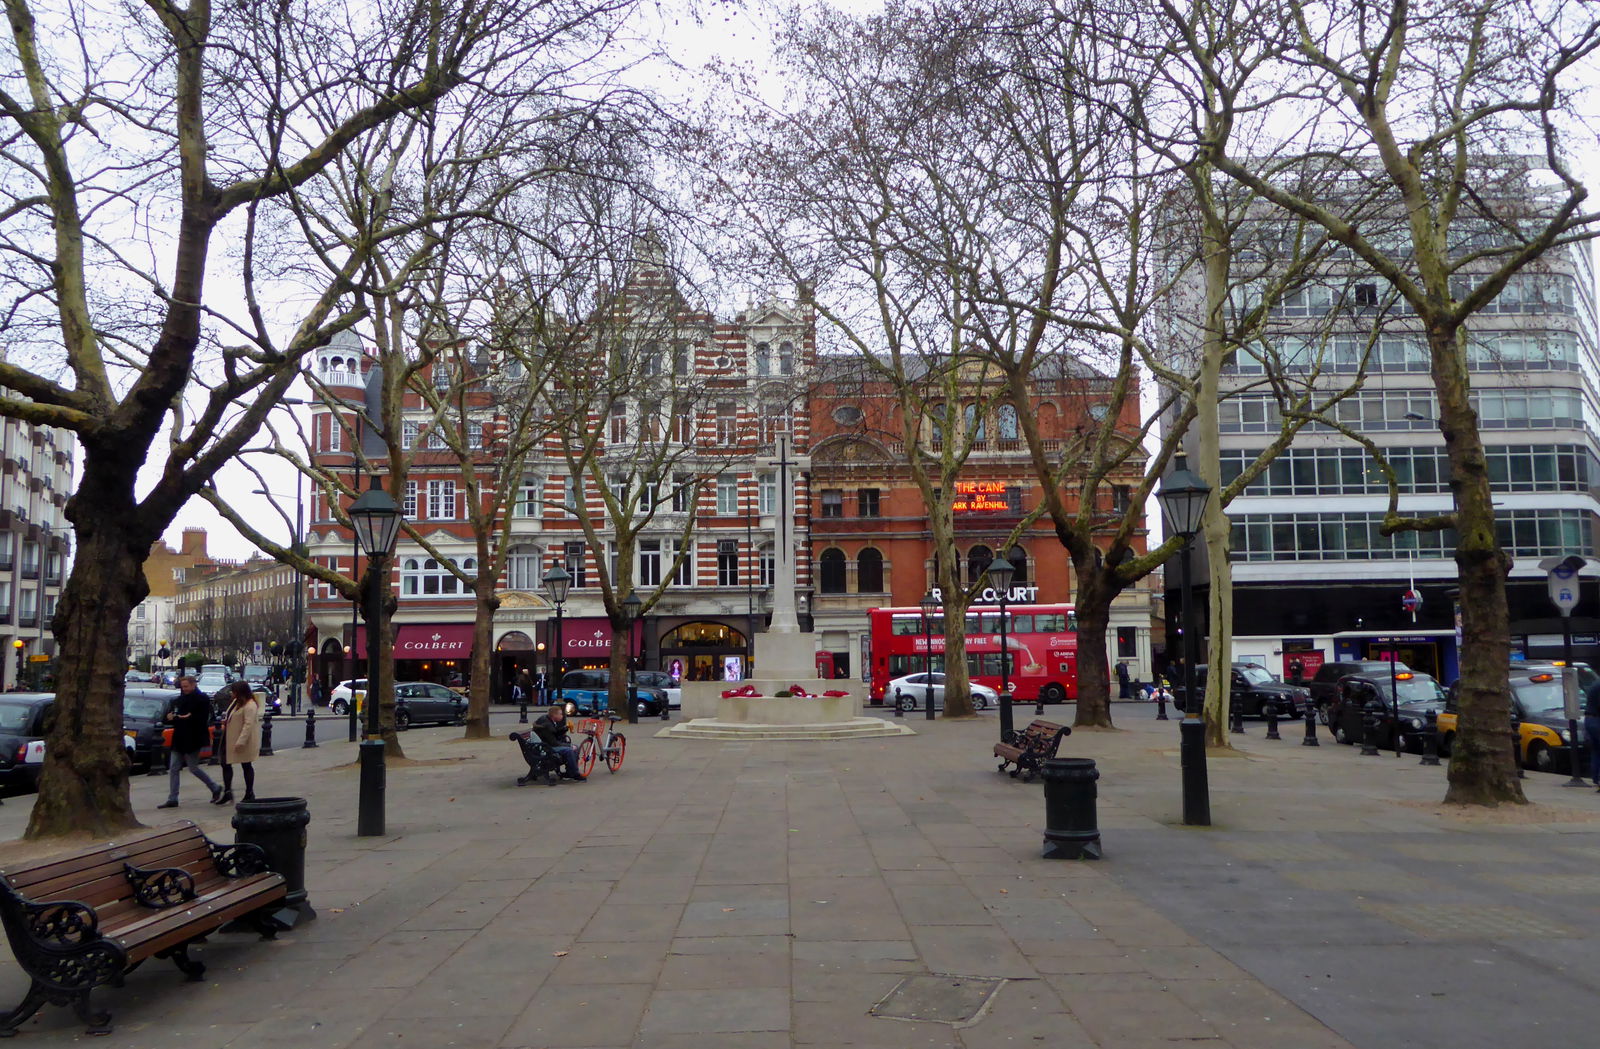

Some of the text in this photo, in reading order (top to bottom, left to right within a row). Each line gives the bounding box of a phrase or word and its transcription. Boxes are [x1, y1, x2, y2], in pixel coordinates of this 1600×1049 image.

[956, 481, 1006, 493] THE CANE
[976, 494, 986, 502] BY
[952, 501, 1008, 510] ARK RAVENHILL
[404, 641, 464, 650] COLBERT
[568, 639, 612, 648] COLBE
